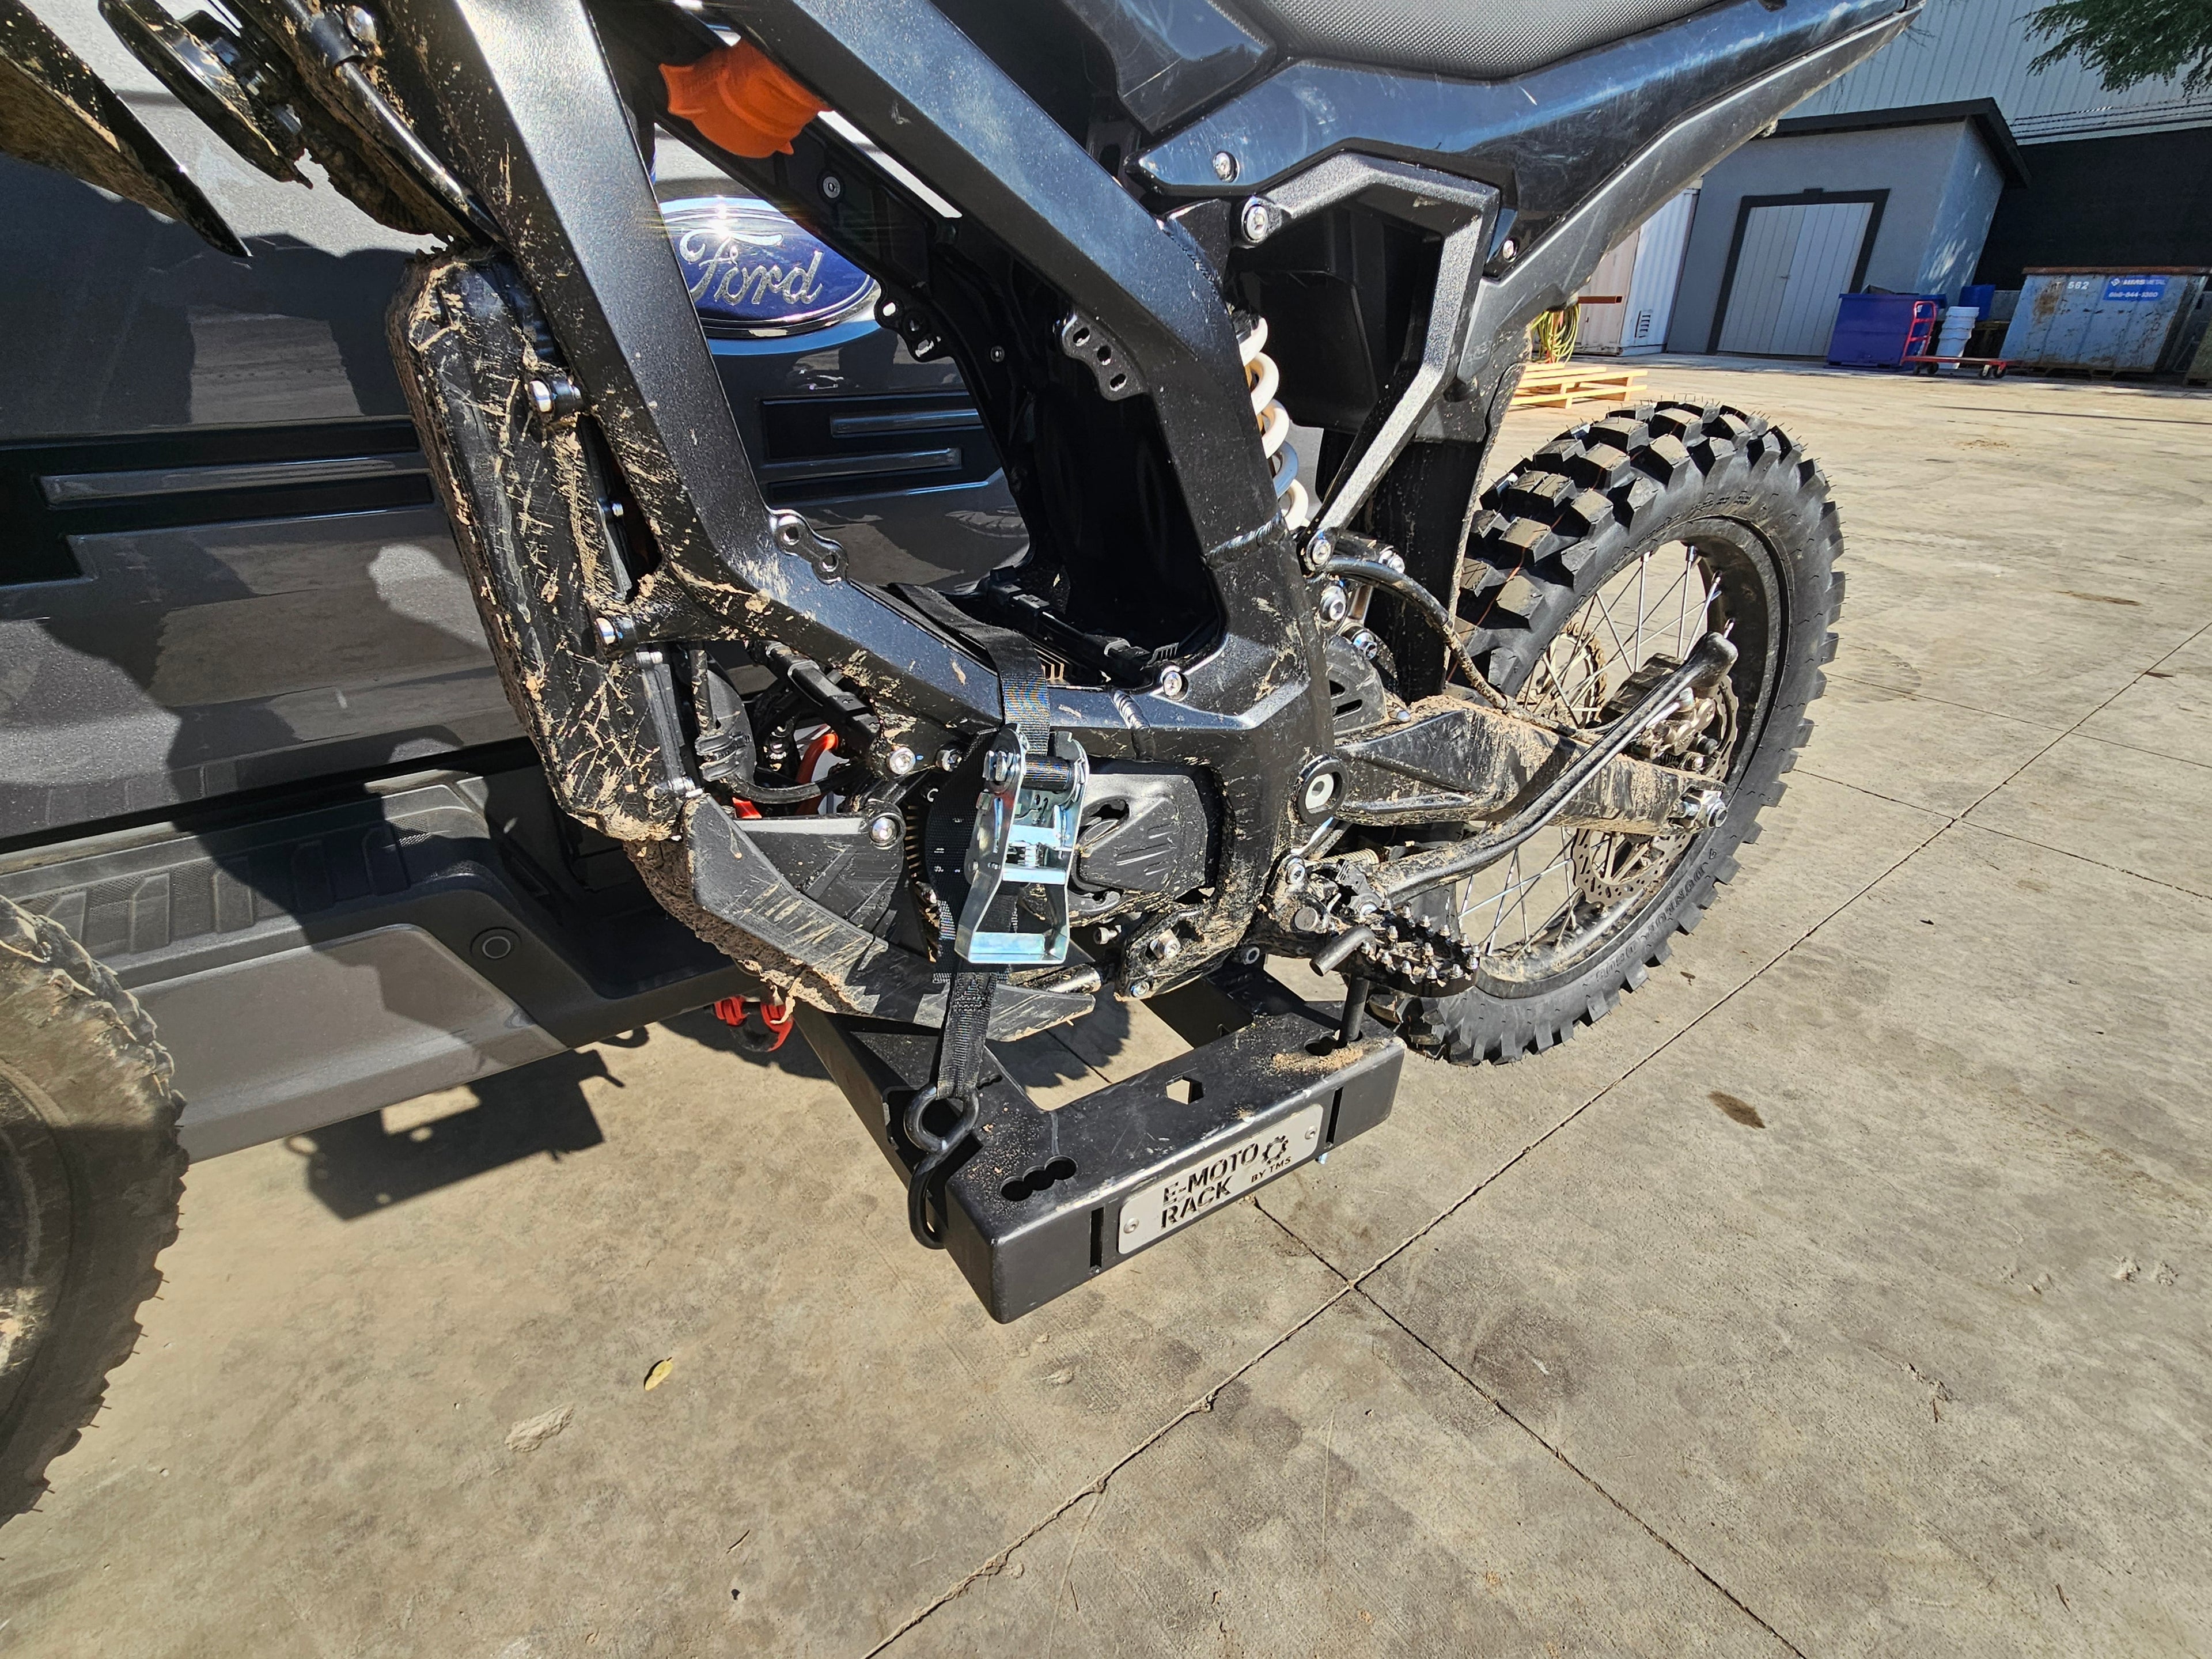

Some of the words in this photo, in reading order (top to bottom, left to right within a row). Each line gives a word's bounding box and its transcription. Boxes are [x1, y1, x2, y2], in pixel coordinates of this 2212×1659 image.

[679, 229, 823, 305] Ford
[1645, 866, 1706, 940] DUNLOP
[1162, 1143, 1259, 1206] E-MOTO
[1251, 1169, 1266, 1183] BY
[1269, 1156, 1292, 1173] TMS
[1160, 1175, 1233, 1230] RACK
